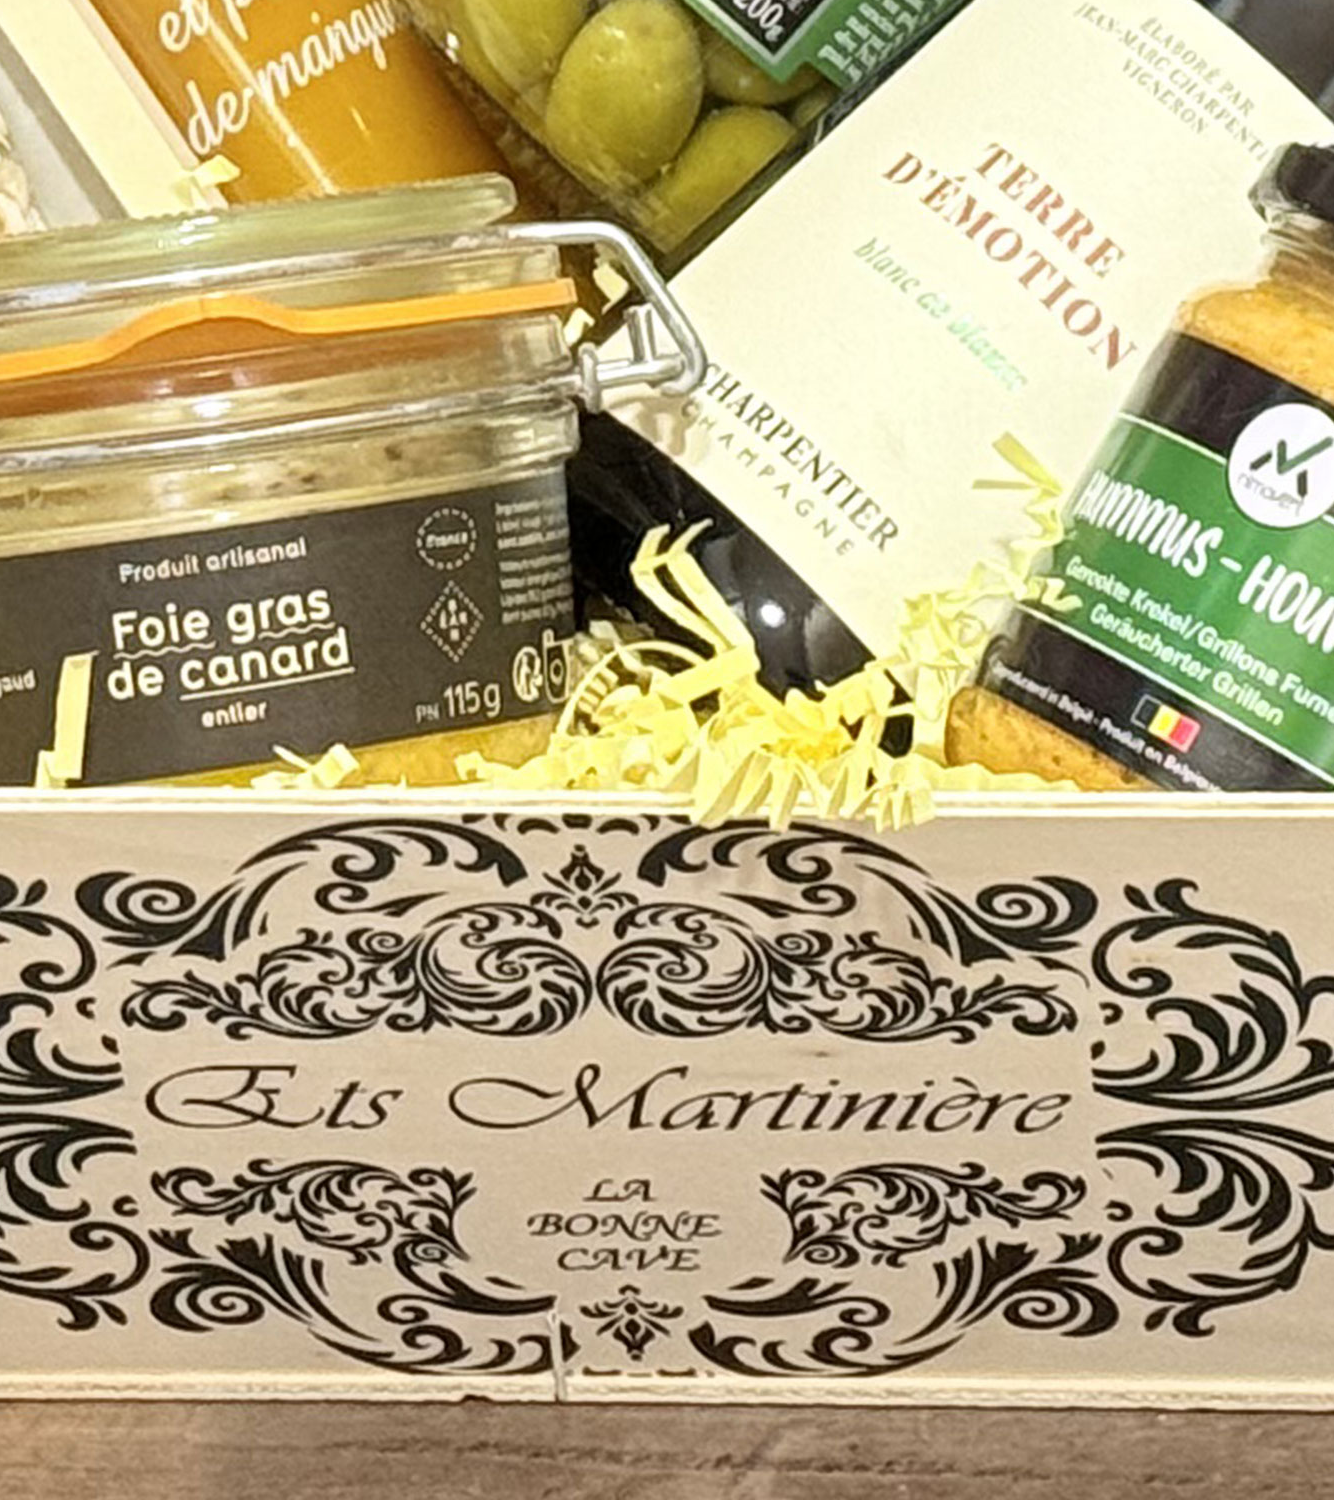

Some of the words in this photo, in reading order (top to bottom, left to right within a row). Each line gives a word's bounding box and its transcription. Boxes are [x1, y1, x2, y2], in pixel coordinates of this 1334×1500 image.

[1122, 58, 1208, 134] VIGNERON
[1140, 16, 1222, 85] ÉLABORÉ
[1217, 81, 1255, 116] PAR
[189, 80, 257, 157] de
[972, 142, 1127, 280] TERRE
[853, 237, 922, 295] blanc
[879, 150, 1138, 374] D'ÉMOTION
[679, 400, 858, 558] CHAMPAGNE
[119, 553, 200, 584] Produit
[206, 537, 308, 571] artisanal
[113, 603, 211, 654] Foie
[230, 587, 331, 638] gras
[107, 657, 163, 700] de
[179, 627, 350, 691] canard
[202, 701, 267, 727] entier
[1212, 671, 1285, 728] Grillen
[1099, 718, 1146, 753] Produit
[1144, 746, 1163, 764] en
[1163, 755, 1223, 792] Belgiqu
[146, 1064, 404, 1132] Ets
[449, 1064, 1072, 1133] Martinière
[525, 1212, 723, 1240] BONNE
[581, 1178, 657, 1206] LA
[556, 1247, 702, 1274] CAVE
